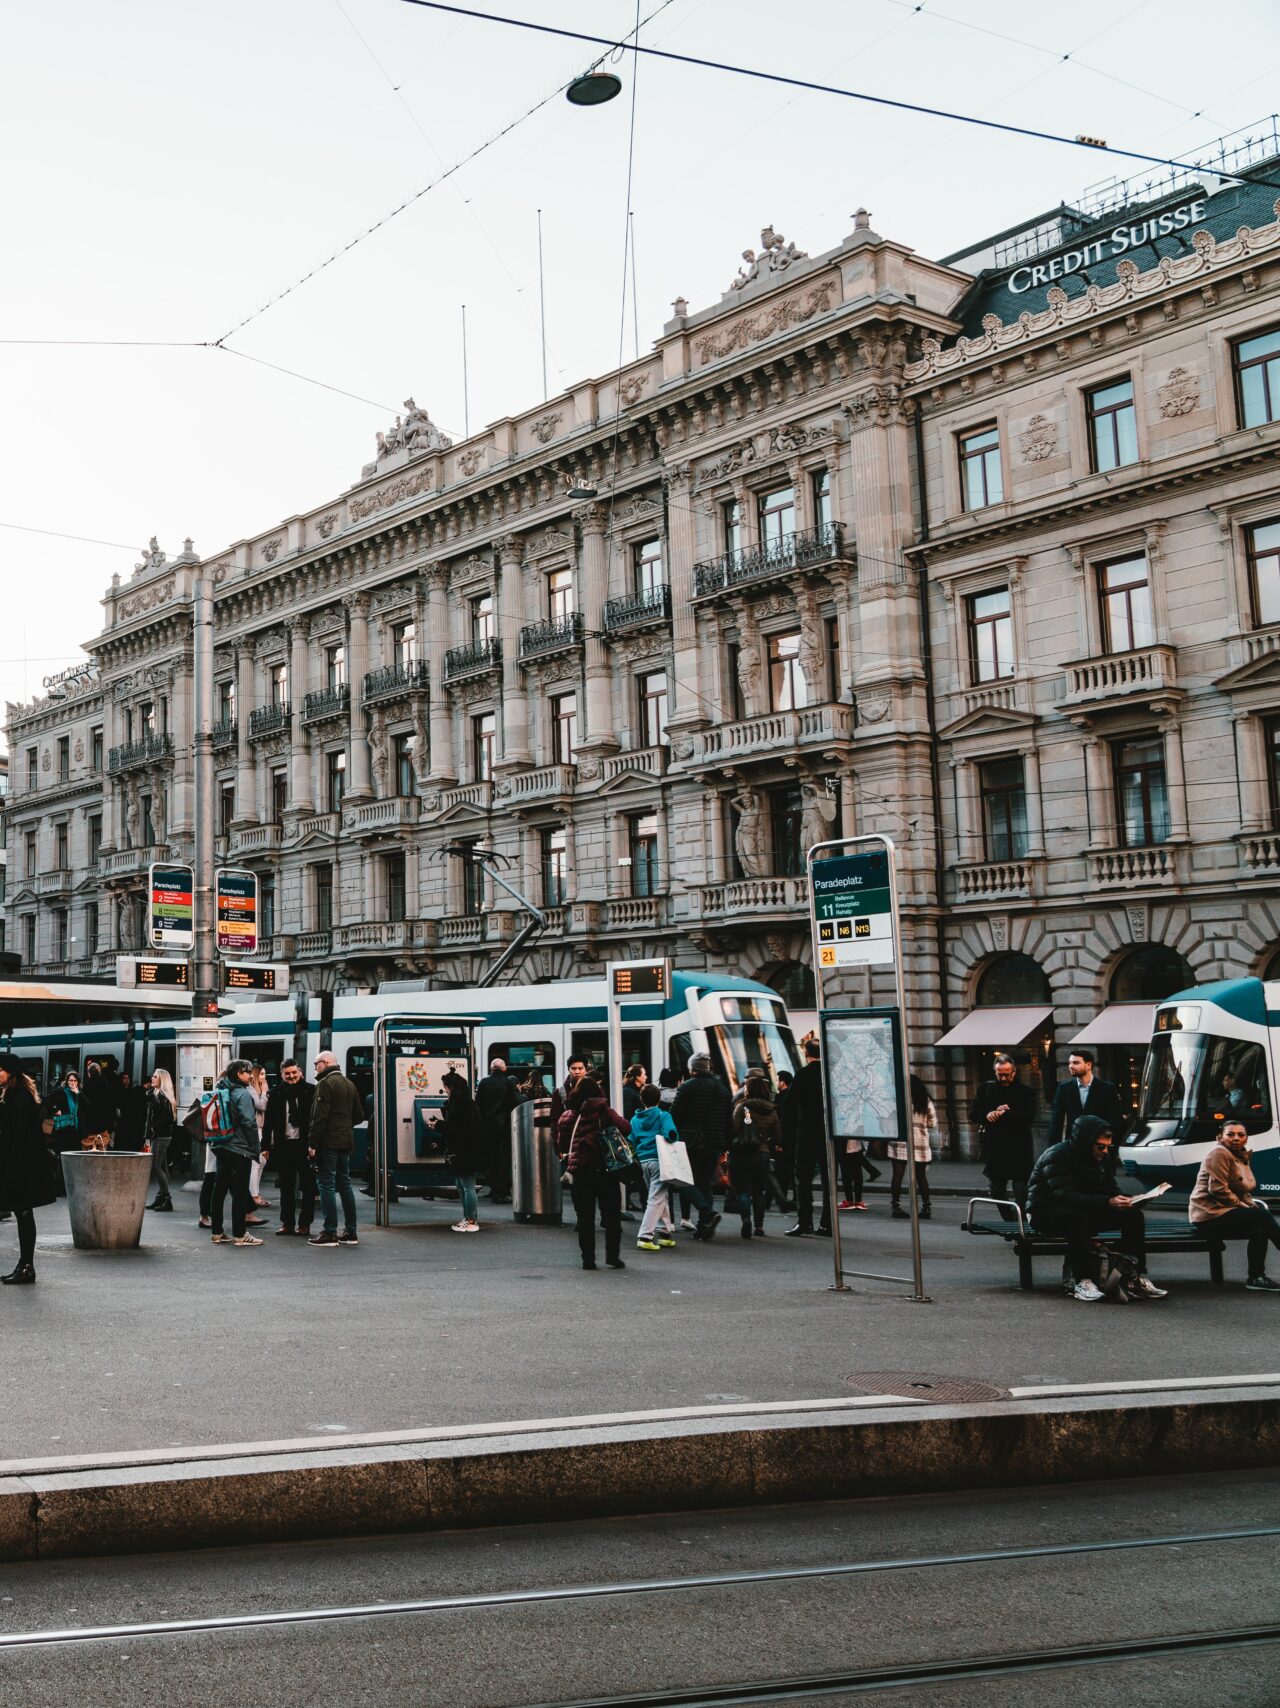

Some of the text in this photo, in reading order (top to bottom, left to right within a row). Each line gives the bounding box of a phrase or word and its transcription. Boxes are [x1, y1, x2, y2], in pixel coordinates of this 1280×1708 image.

[1007, 200, 1207, 294] CREDIT SUISSE
[154, 881, 181, 890] Paradeplatz
[814, 876, 863, 890] Paradeplatz
[219, 887, 245, 895] Paradeplatz
[821, 904, 834, 917] 11
[821, 929, 831, 937] N1
[839, 927, 850, 935] N6
[855, 924, 870, 934] N13
[822, 951, 834, 962] 21
[390, 1037, 426, 1046] Paradeplatz
[1260, 1183, 1280, 1191] 3020
